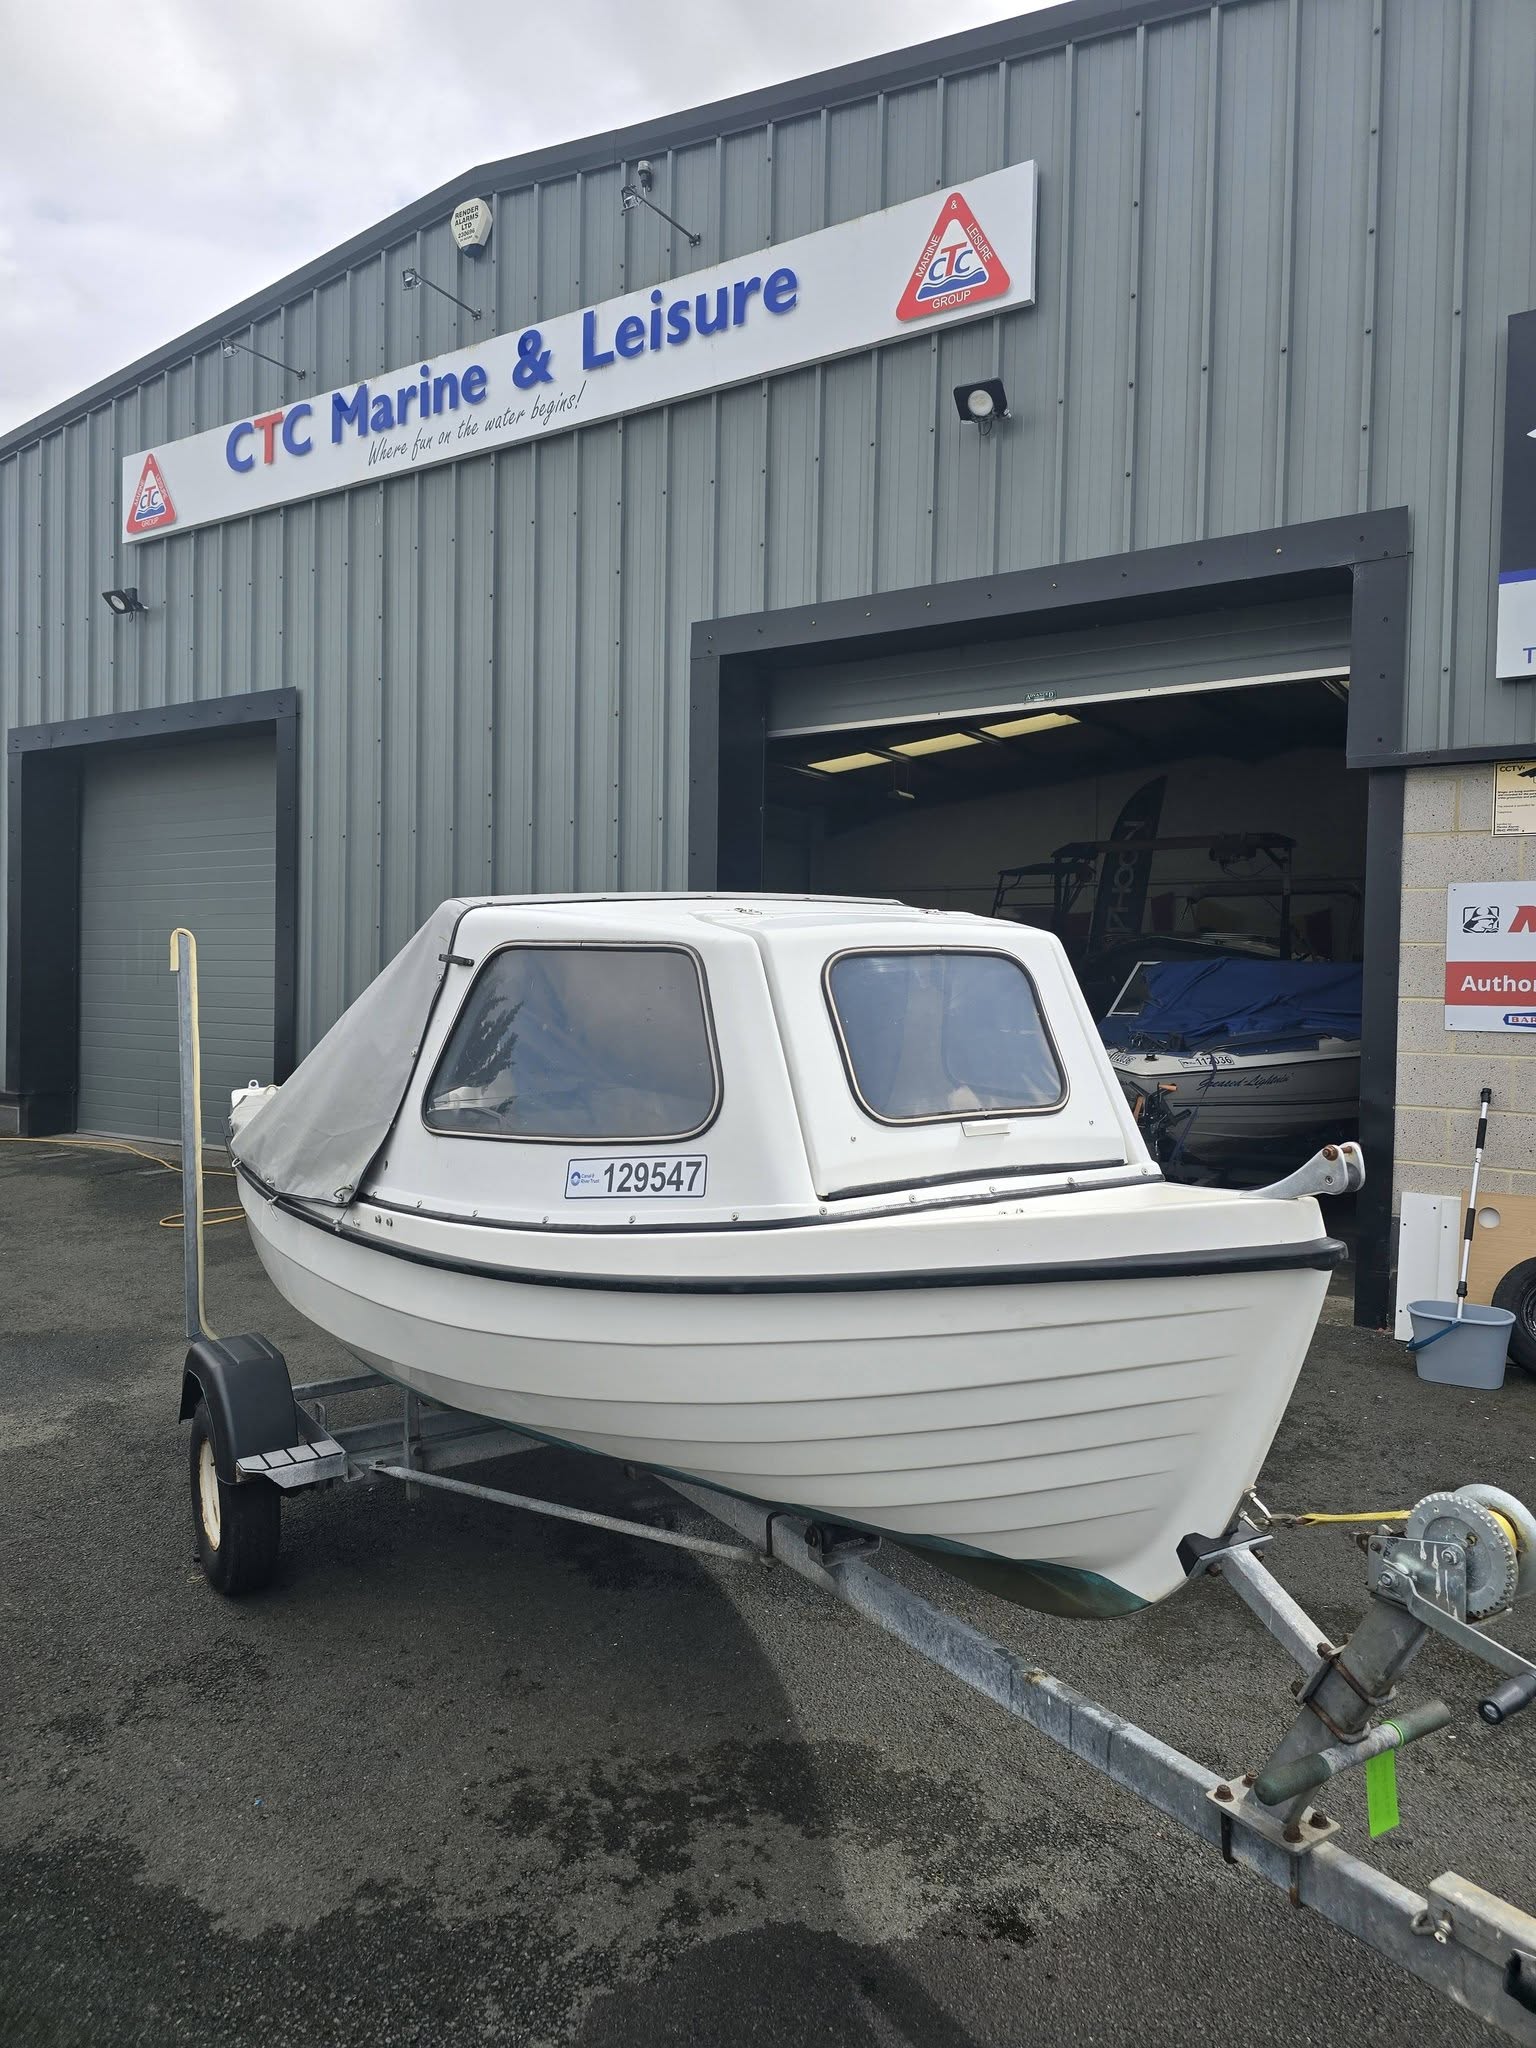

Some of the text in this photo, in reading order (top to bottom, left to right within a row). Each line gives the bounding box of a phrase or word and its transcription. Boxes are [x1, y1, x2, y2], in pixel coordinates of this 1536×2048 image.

[455, 205, 479, 219] RENDER
[951, 200, 958, 209] &
[455, 212, 479, 226] ALARMS
[461, 222, 472, 230] LTD
[966, 223, 993, 263] LEISURE
[915, 234, 940, 278] MARINE
[928, 241, 973, 281] CTC
[932, 290, 971, 309] GROUP
[226, 268, 798, 473] CTC Marine & Leisure
[368, 381, 586, 466] Where fun on the water begins!
[140, 486, 159, 509] CTC
[141, 516, 160, 528] GROUP
[1460, 975, 1536, 992] Autho
[604, 1161, 702, 1193] 129547
